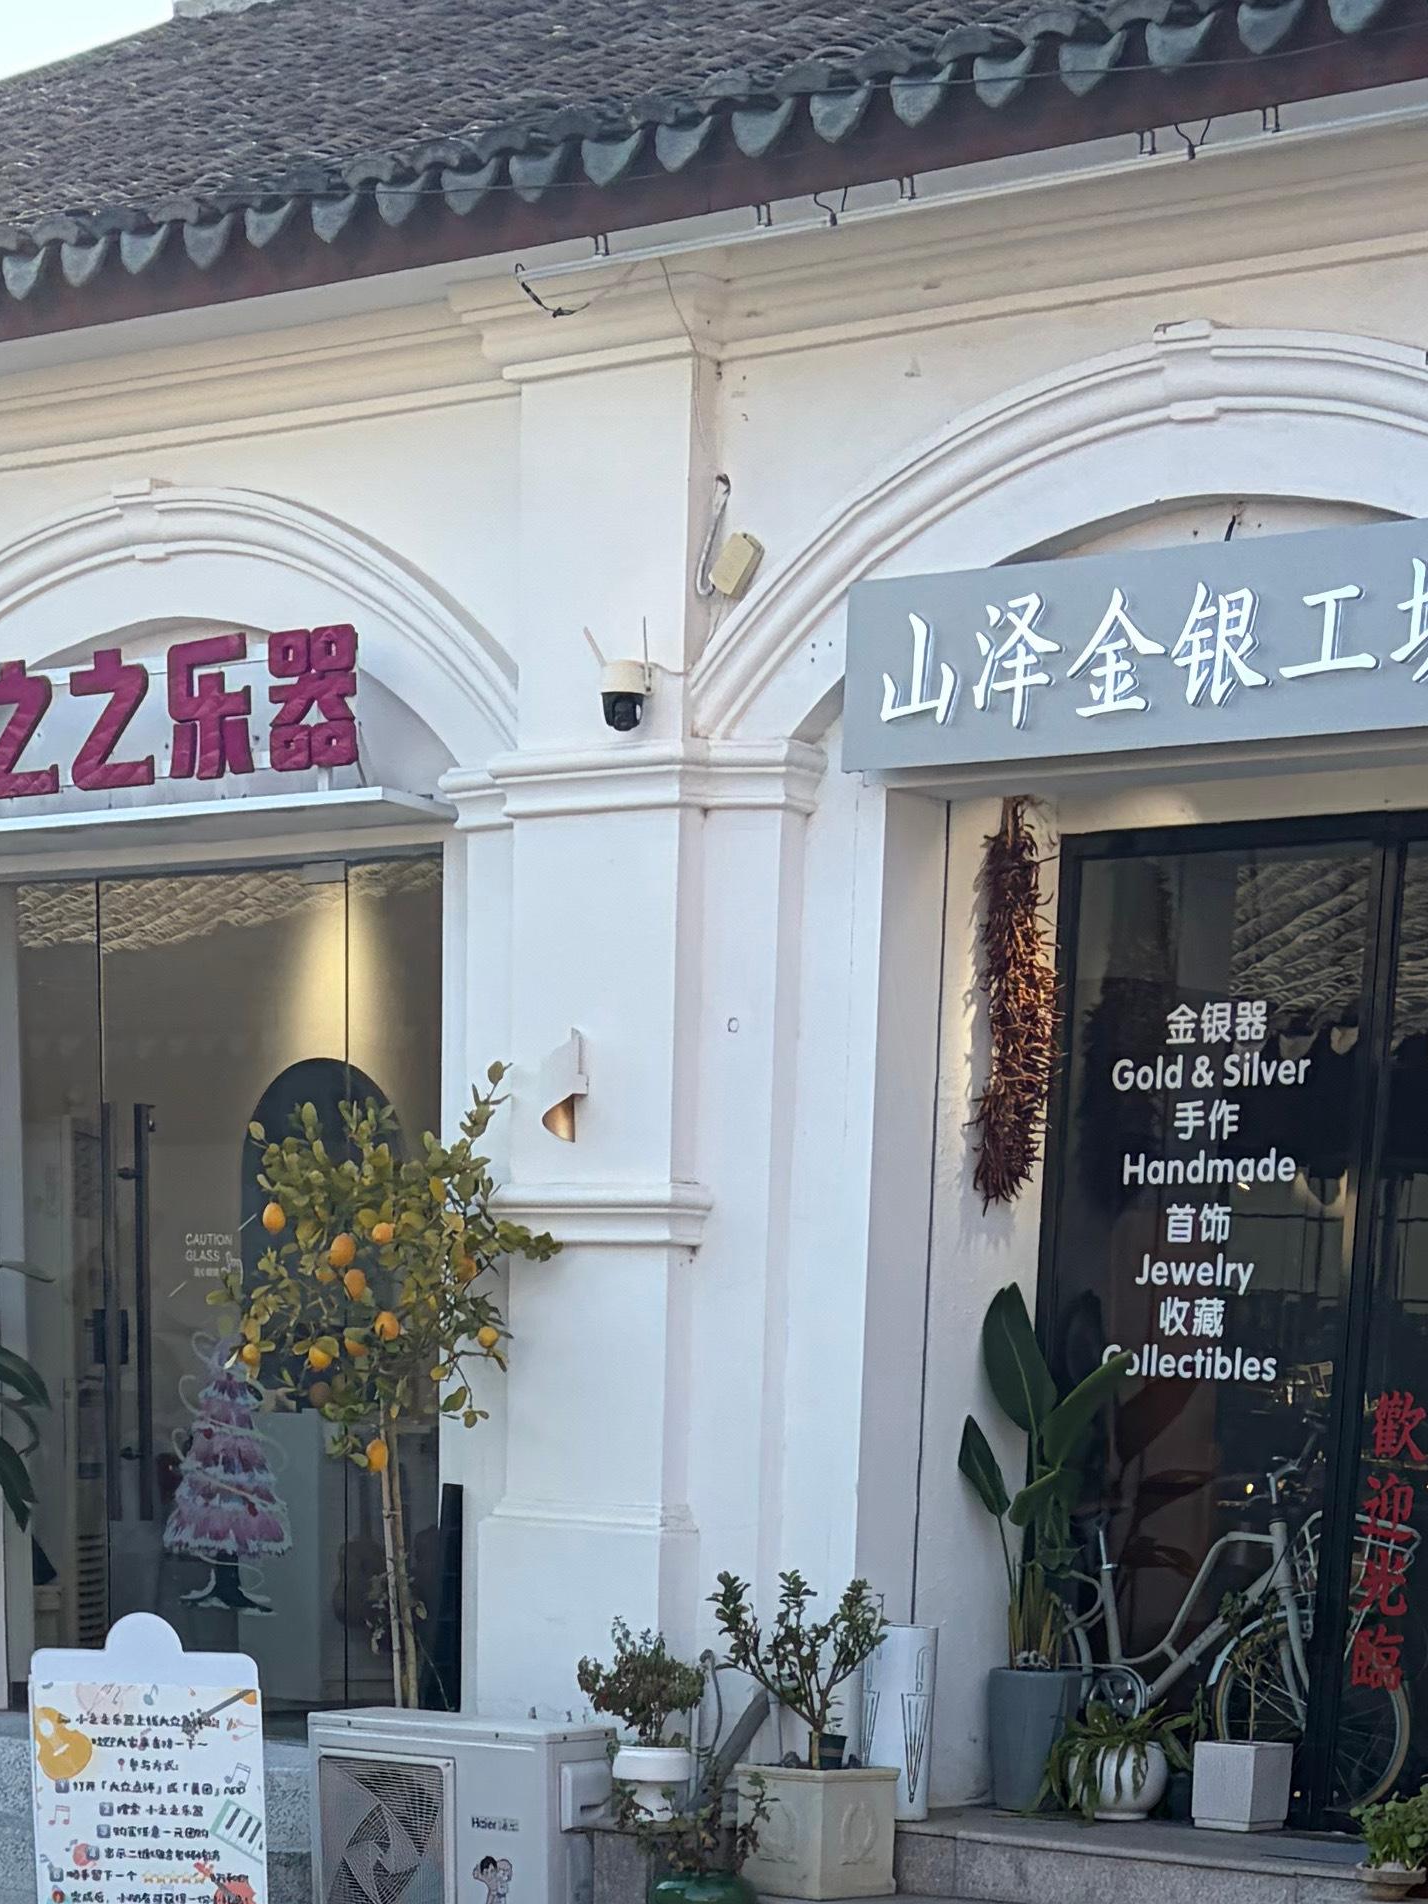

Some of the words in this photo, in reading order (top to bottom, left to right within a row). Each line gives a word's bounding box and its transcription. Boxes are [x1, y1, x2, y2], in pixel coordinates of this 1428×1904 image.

[1165, 1000, 1268, 1045] 金银器
[1112, 1054, 1183, 1091] Gold
[1191, 1055, 1215, 1088] &
[1223, 1051, 1311, 1087] Silver
[1173, 1099, 1240, 1140] 手作
[1123, 1147, 1296, 1185] Handmade
[185, 1233, 233, 1246] CAUTION
[1166, 1203, 1232, 1244] 首饰
[185, 1249, 220, 1262] GLASS
[1135, 1253, 1254, 1295] Jewelry
[1159, 1297, 1225, 1338] 收藏
[1351, 1389, 1428, 1691] 歡迎光臨
